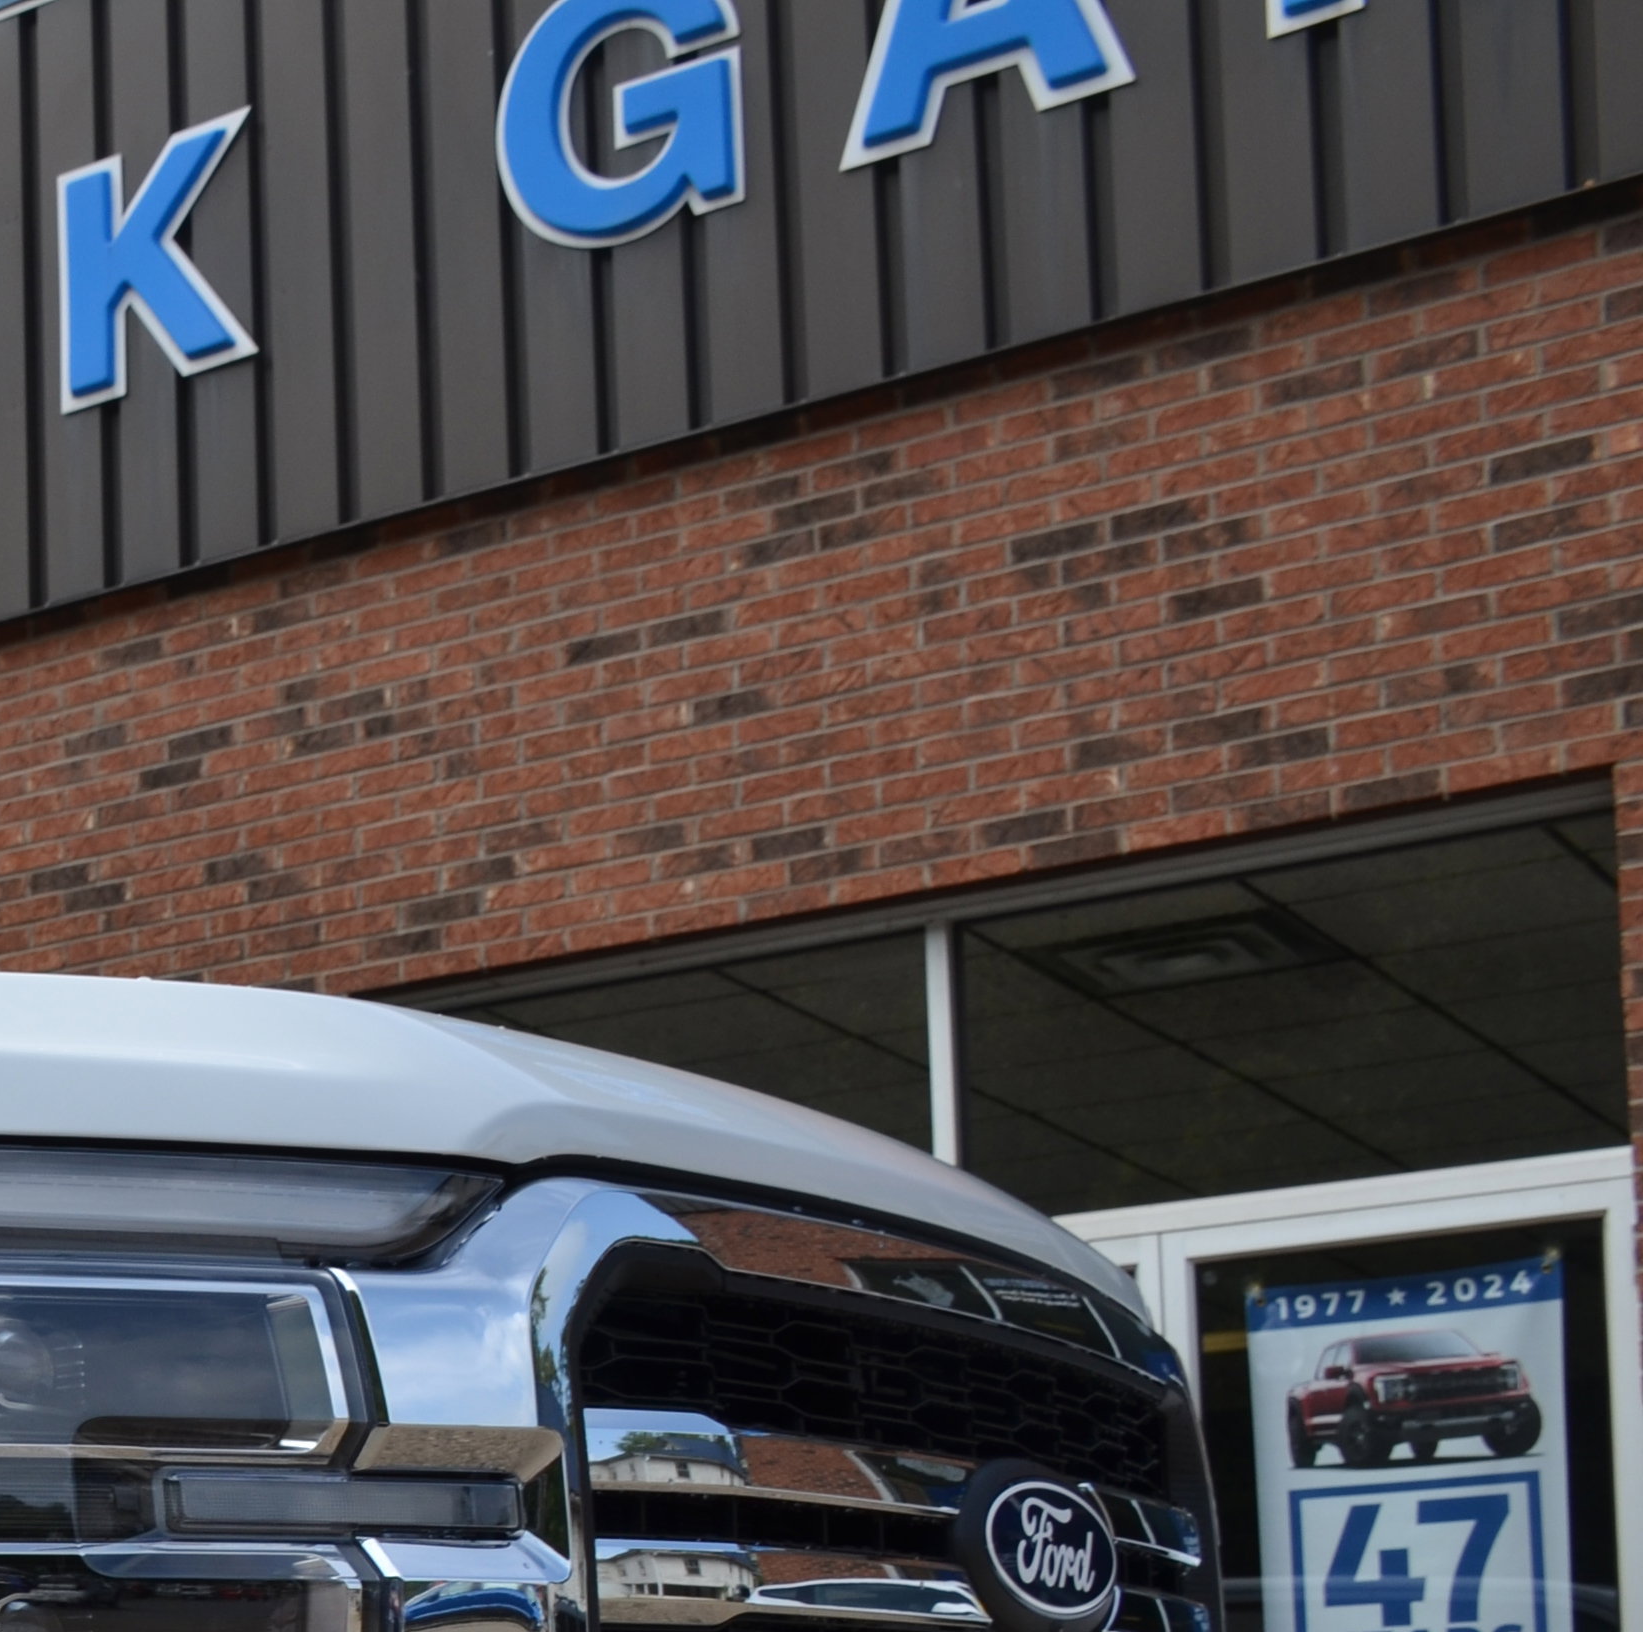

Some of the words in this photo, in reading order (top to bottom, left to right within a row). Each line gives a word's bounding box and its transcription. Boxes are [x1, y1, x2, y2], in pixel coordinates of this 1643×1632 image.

[496, 0, 1365, 249] GA
[1275, 1289, 1367, 1321] 1977
[1425, 1268, 1534, 1307] 2024
[1016, 1496, 1096, 1593] Ford
[1323, 1493, 1511, 1629] 47
